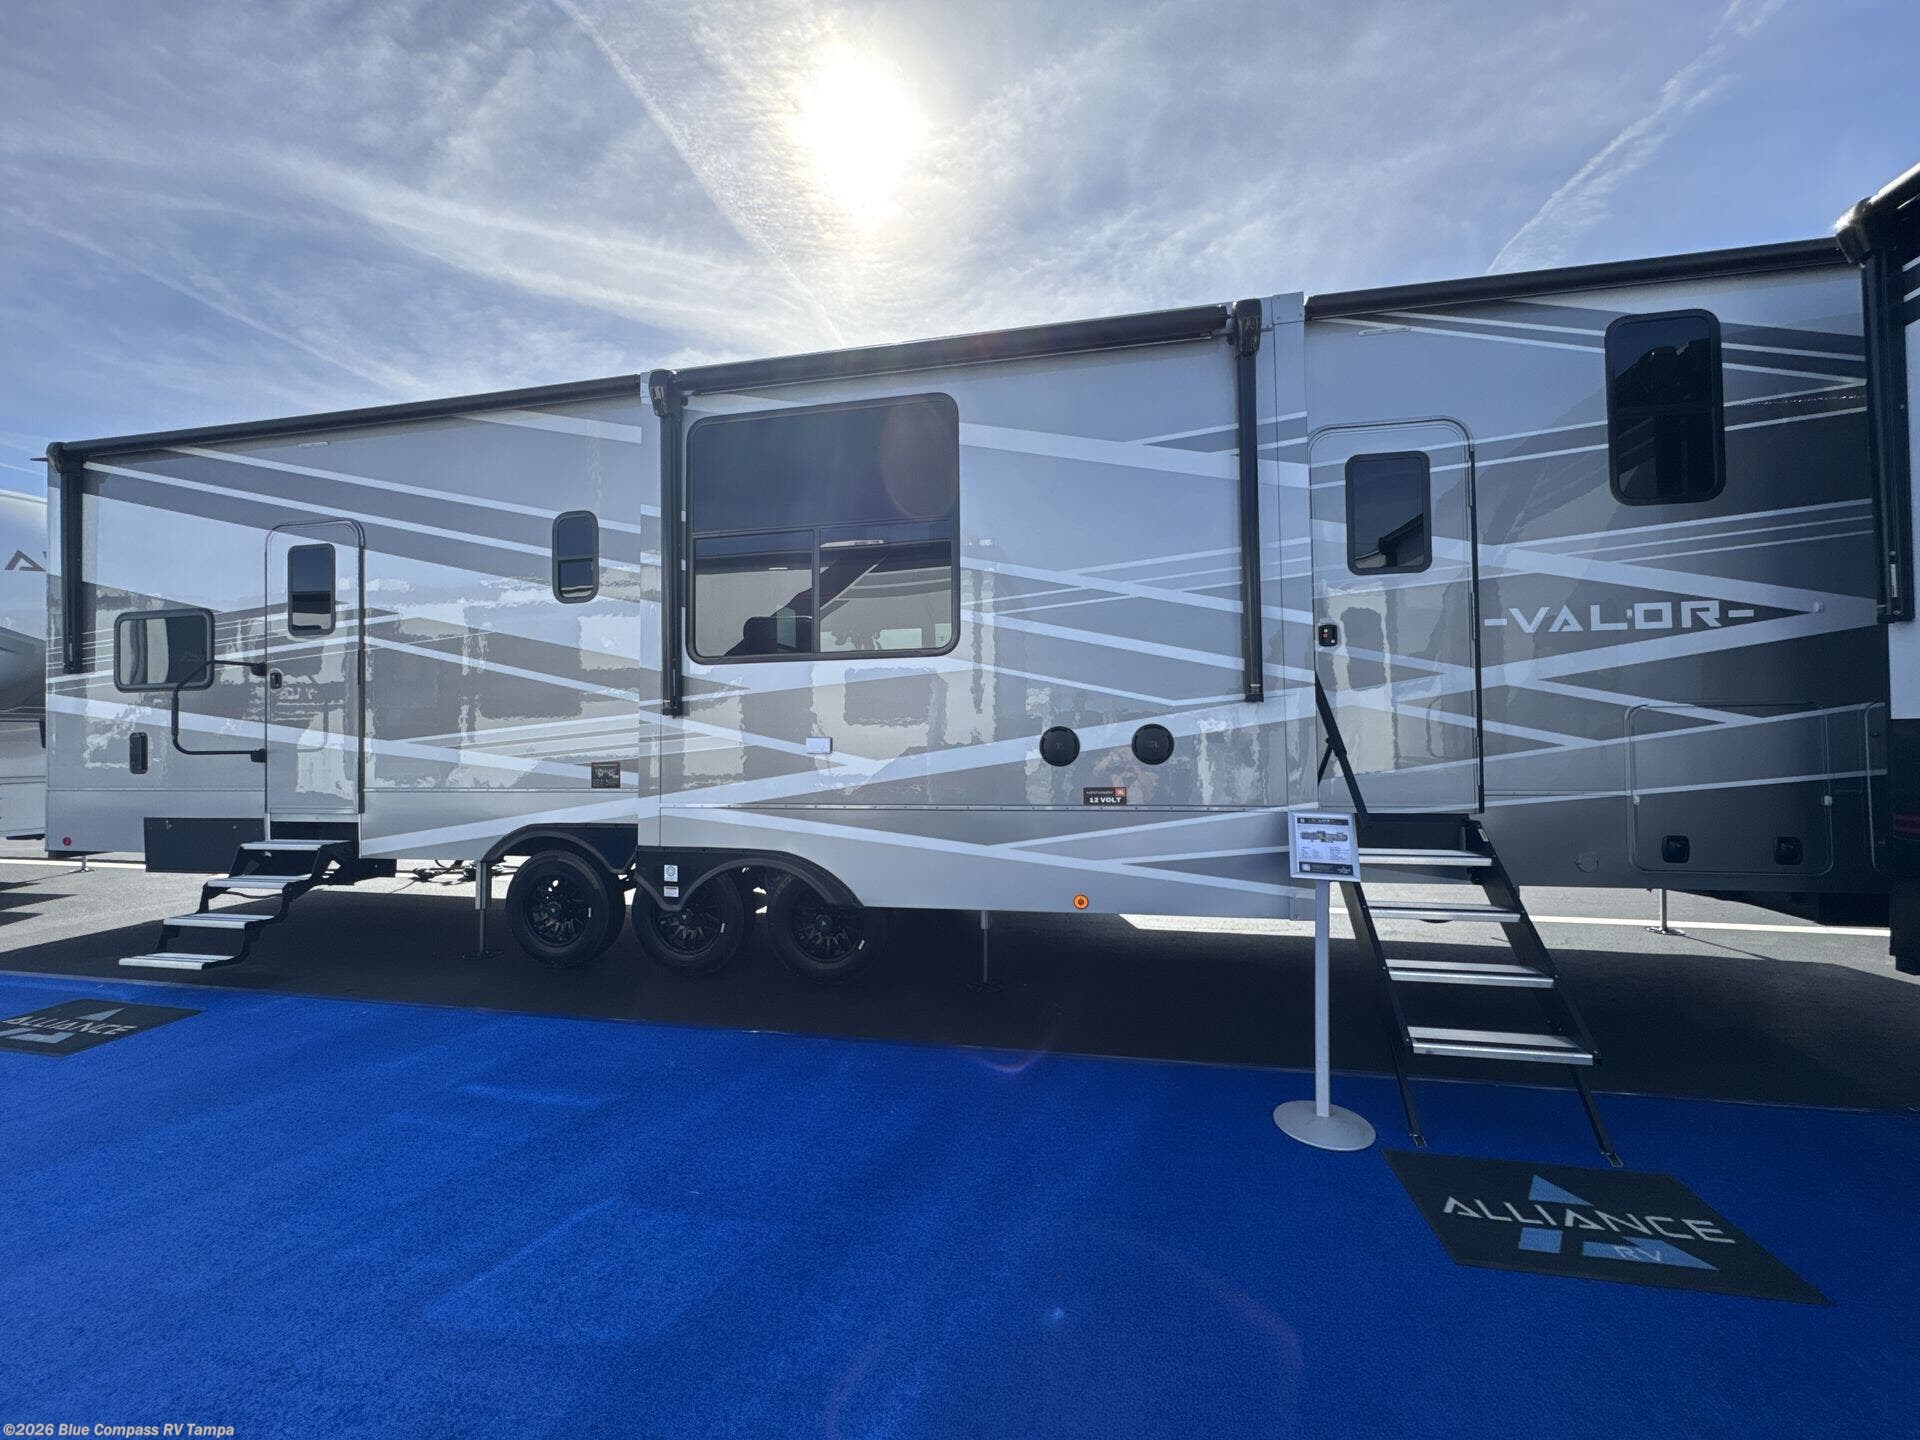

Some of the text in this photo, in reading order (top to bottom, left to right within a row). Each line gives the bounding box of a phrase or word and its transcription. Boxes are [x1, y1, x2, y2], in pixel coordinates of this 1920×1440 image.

[1, 1016, 138, 1035] ALLIANCE
[1443, 1196, 1735, 1244] ALLIANCE
[1614, 1245, 1661, 1262] RV
